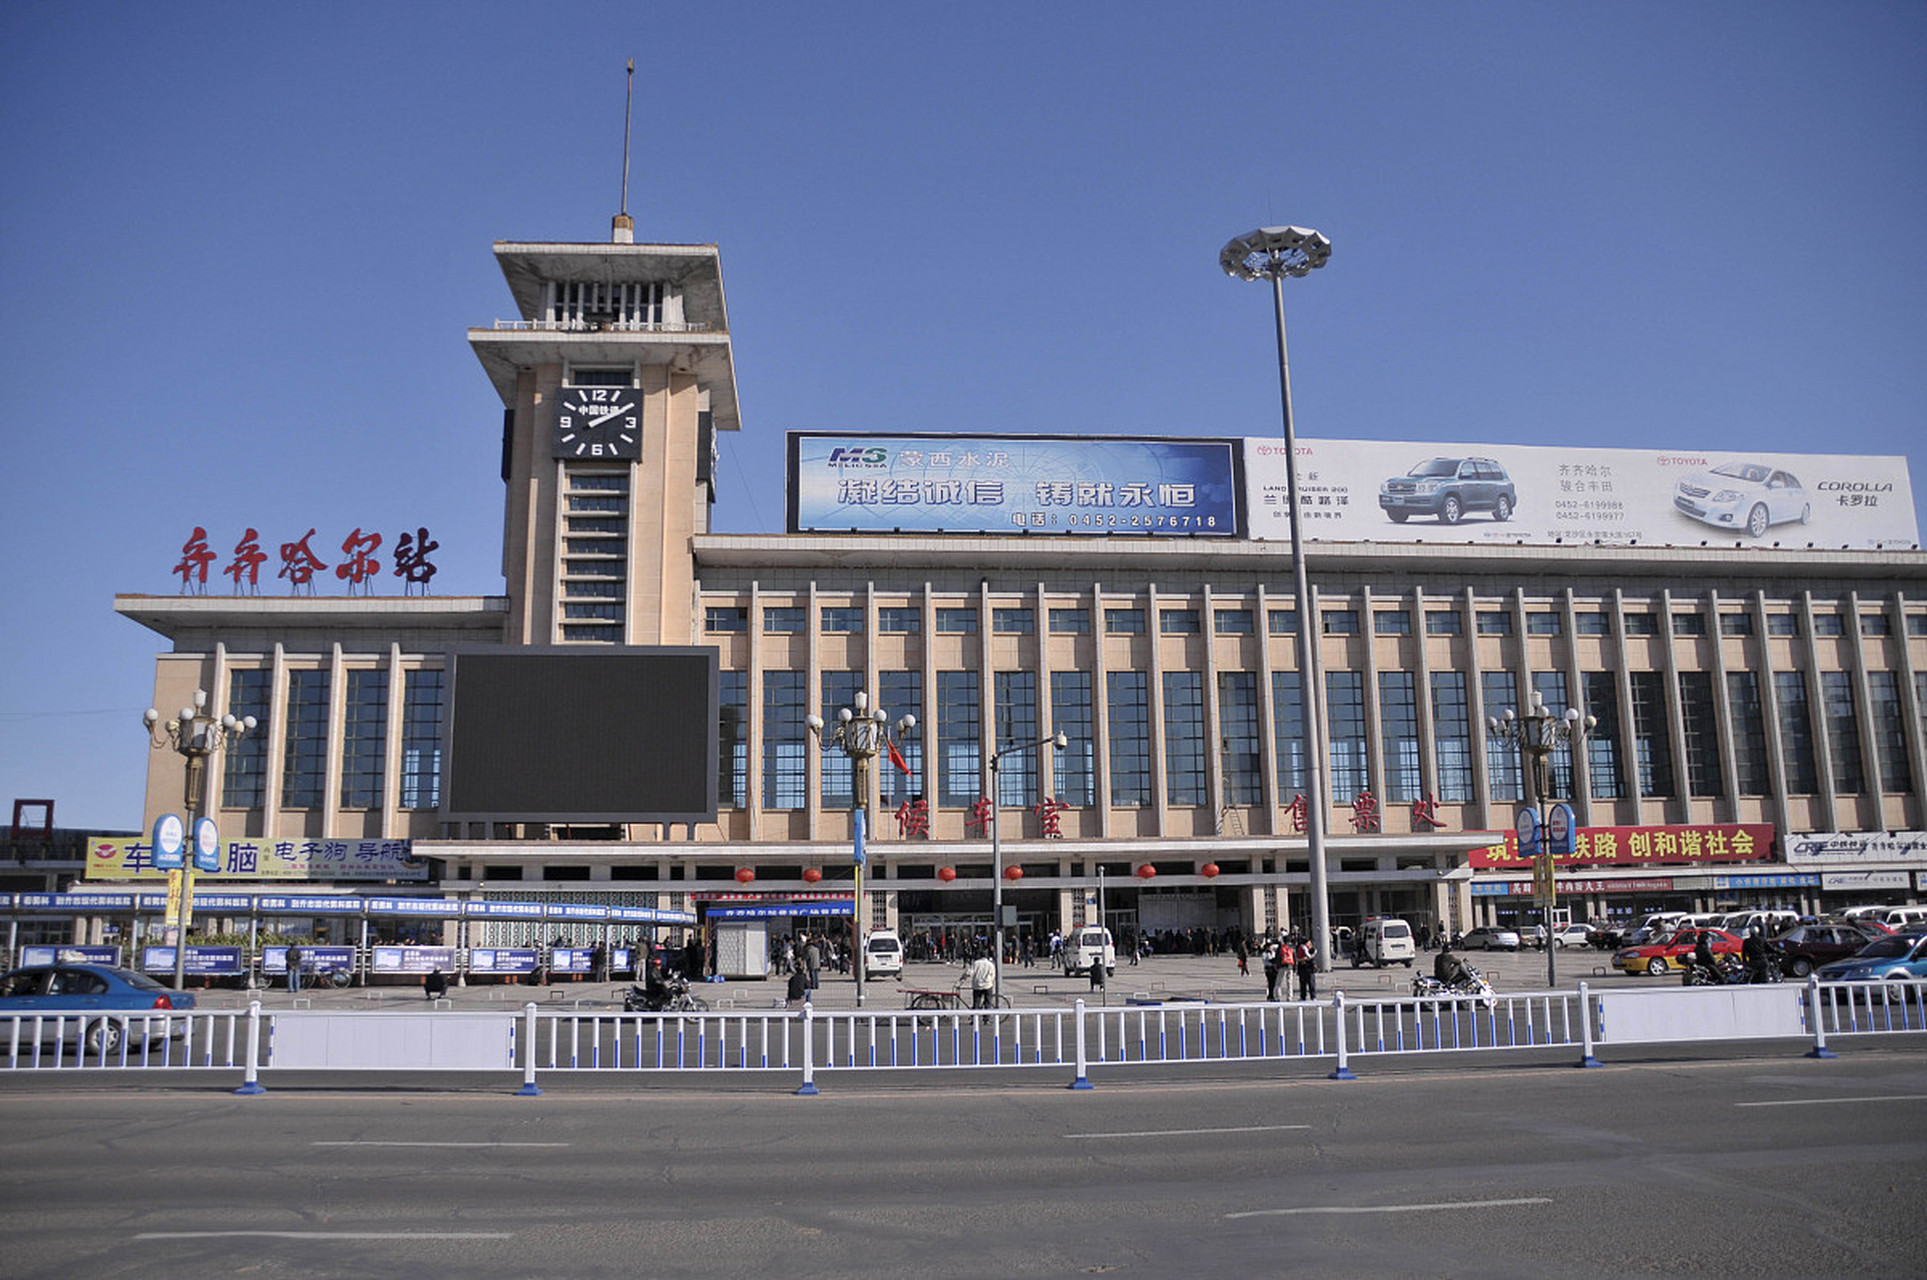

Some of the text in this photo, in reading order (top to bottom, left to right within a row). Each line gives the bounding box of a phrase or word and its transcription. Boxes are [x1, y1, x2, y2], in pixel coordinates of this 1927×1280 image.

[592, 390, 607, 401] 12
[560, 416, 571, 428] 9
[624, 417, 636, 428] 3
[592, 444, 603, 455] 6
[1274, 447, 1313, 455] TOOTA
[1672, 457, 1708, 465] TOYOTA
[1559, 464, 1611, 477] 齐齐哈尔
[838, 478, 1196, 507] 凝结诚信 铸就永恒
[1817, 481, 1893, 493] COROLLA
[1836, 496, 1878, 507] 卡罗拉
[1069, 513, 1217, 527] 0452-2576718
[172, 526, 439, 584] 齐齐哈尔站
[894, 796, 1071, 838] 候车室
[1284, 791, 1448, 832] 售票处
[1485, 829, 1754, 861] 筑铁路 创和谐社会
[122, 842, 258, 873] 车脑
[274, 841, 348, 862] 电子狗
[355, 842, 403, 862] 导航
